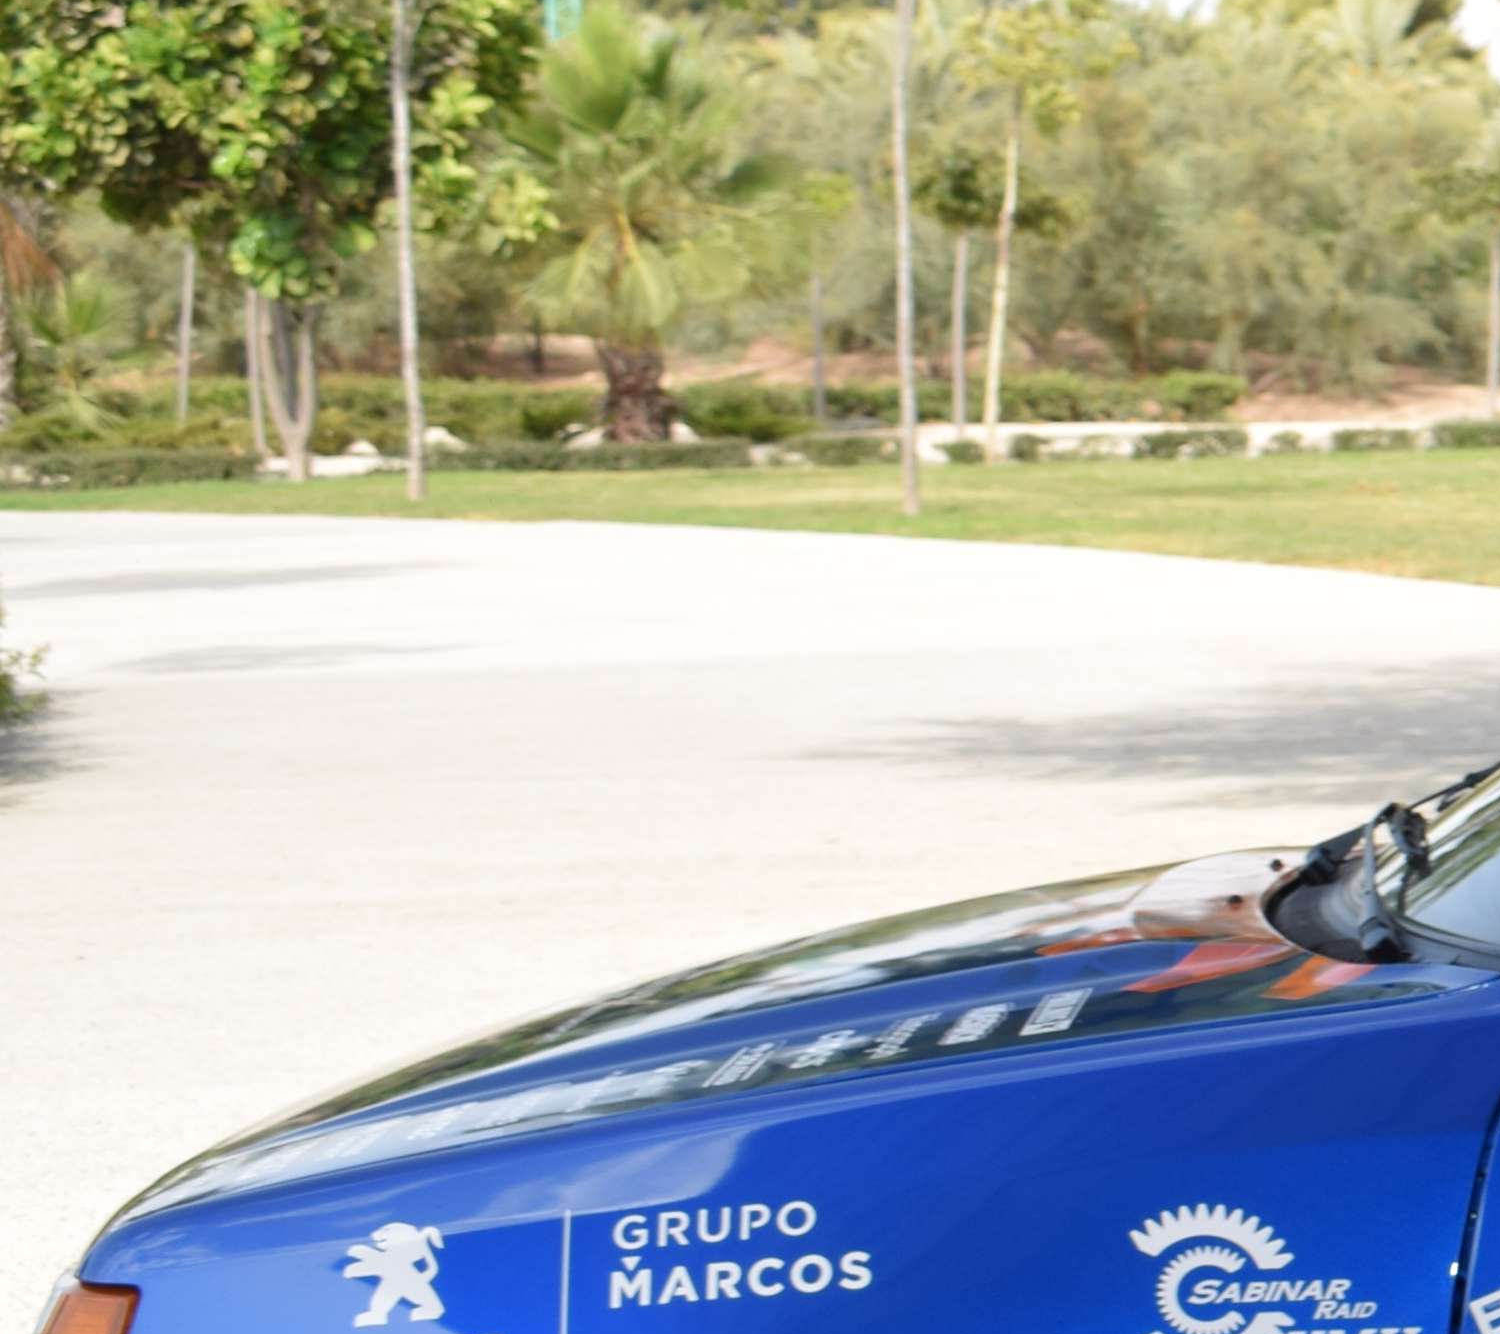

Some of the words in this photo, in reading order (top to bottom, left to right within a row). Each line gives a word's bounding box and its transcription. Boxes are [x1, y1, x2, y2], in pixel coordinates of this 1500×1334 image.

[613, 1200, 817, 1250] GRUPO
[609, 1252, 873, 1309] MARCOS
[1188, 1279, 1351, 1305] SABINAR
[1314, 1301, 1376, 1320] RAID
